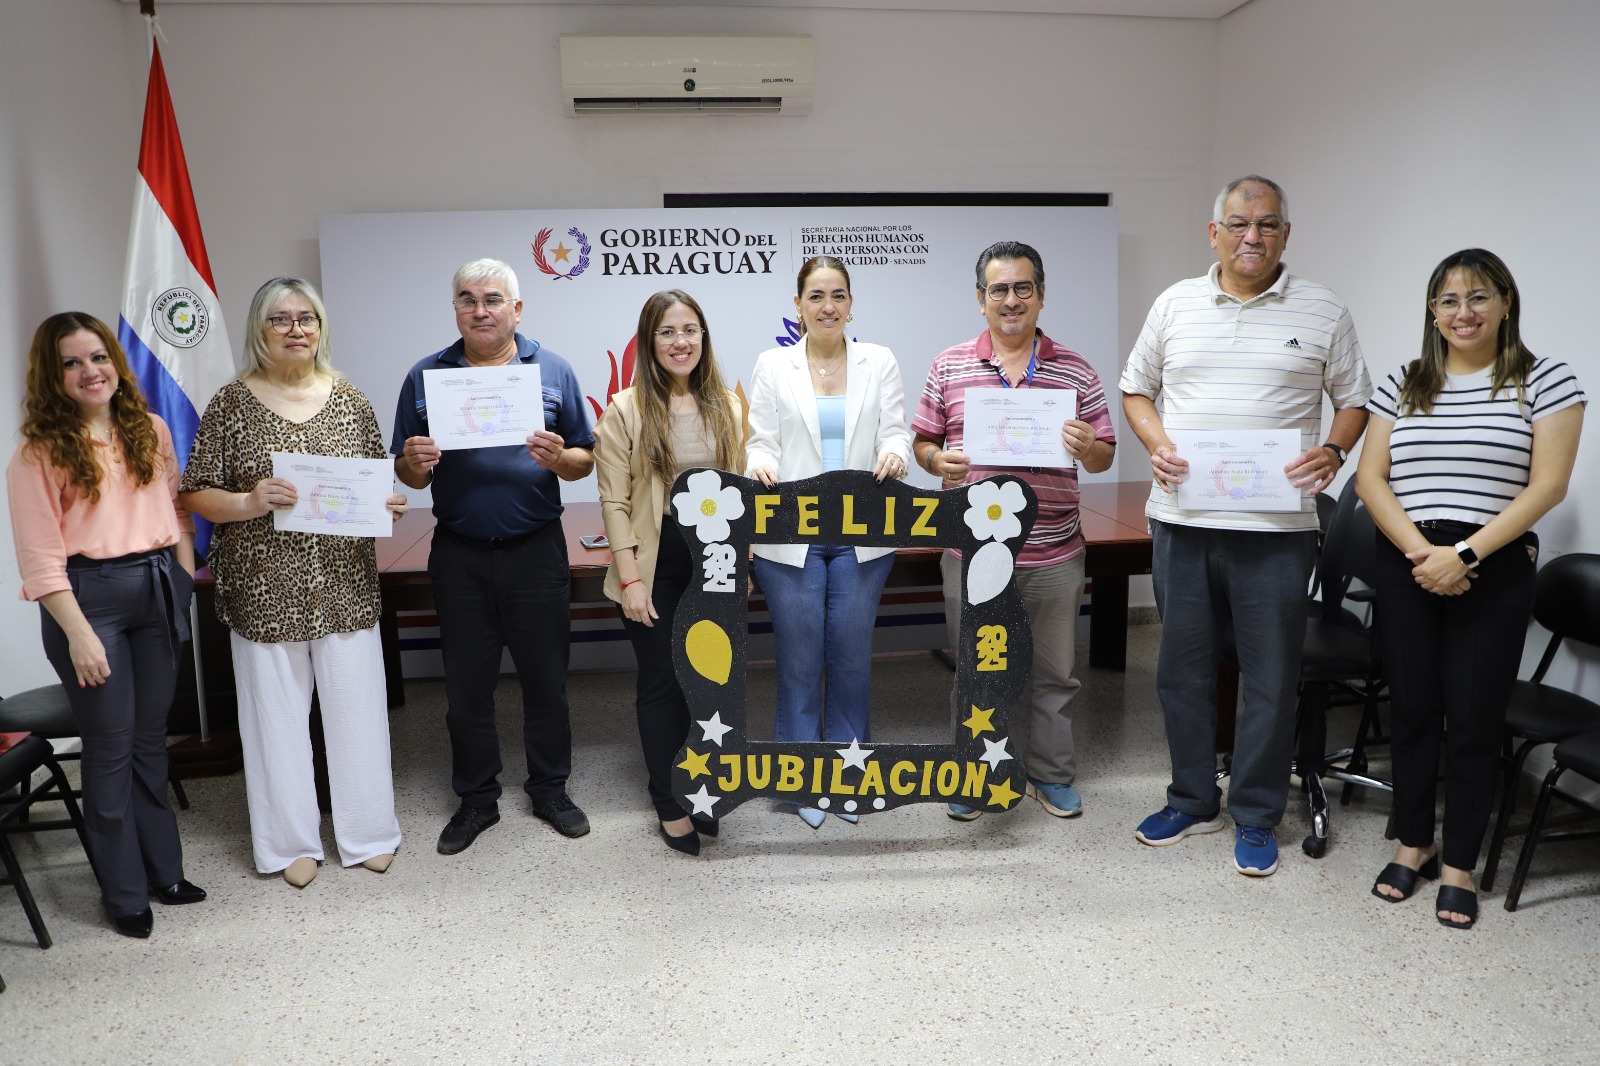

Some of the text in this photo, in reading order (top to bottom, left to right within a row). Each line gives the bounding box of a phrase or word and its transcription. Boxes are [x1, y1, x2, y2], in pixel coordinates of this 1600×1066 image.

[600, 228, 777, 247] GOBIERNO DEL
[801, 233, 925, 243] DERECHOS HUMANOS
[846, 225, 881, 233] NACIONAL
[803, 245, 929, 254] DE LAS PERSONAS CON
[601, 250, 778, 275] PARAGUAY
[192, 299, 202, 313] DEL
[185, 315, 205, 344] PARAGUAY
[754, 494, 940, 537] FELIZ
[717, 753, 989, 798] JUBILACION
